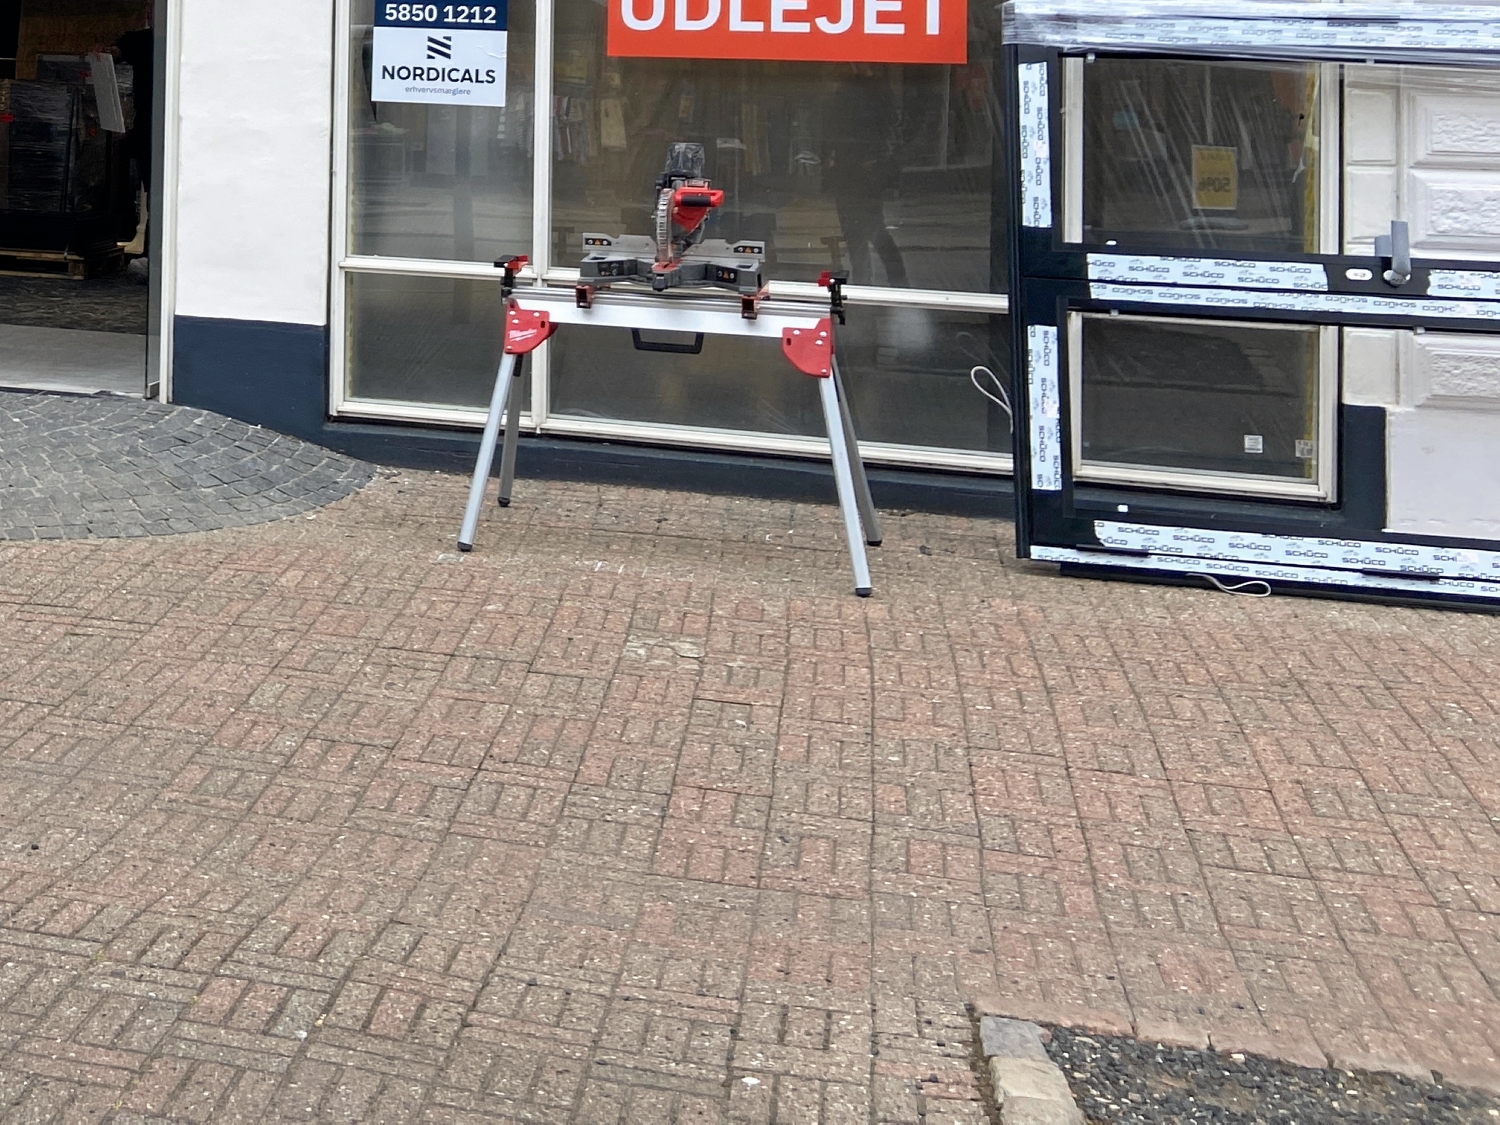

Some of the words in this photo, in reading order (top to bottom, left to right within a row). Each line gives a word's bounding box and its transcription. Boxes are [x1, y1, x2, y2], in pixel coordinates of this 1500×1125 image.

[385, 4, 438, 22] 5850
[443, 5, 497, 23] 1212
[381, 65, 496, 84] NORDICALS
